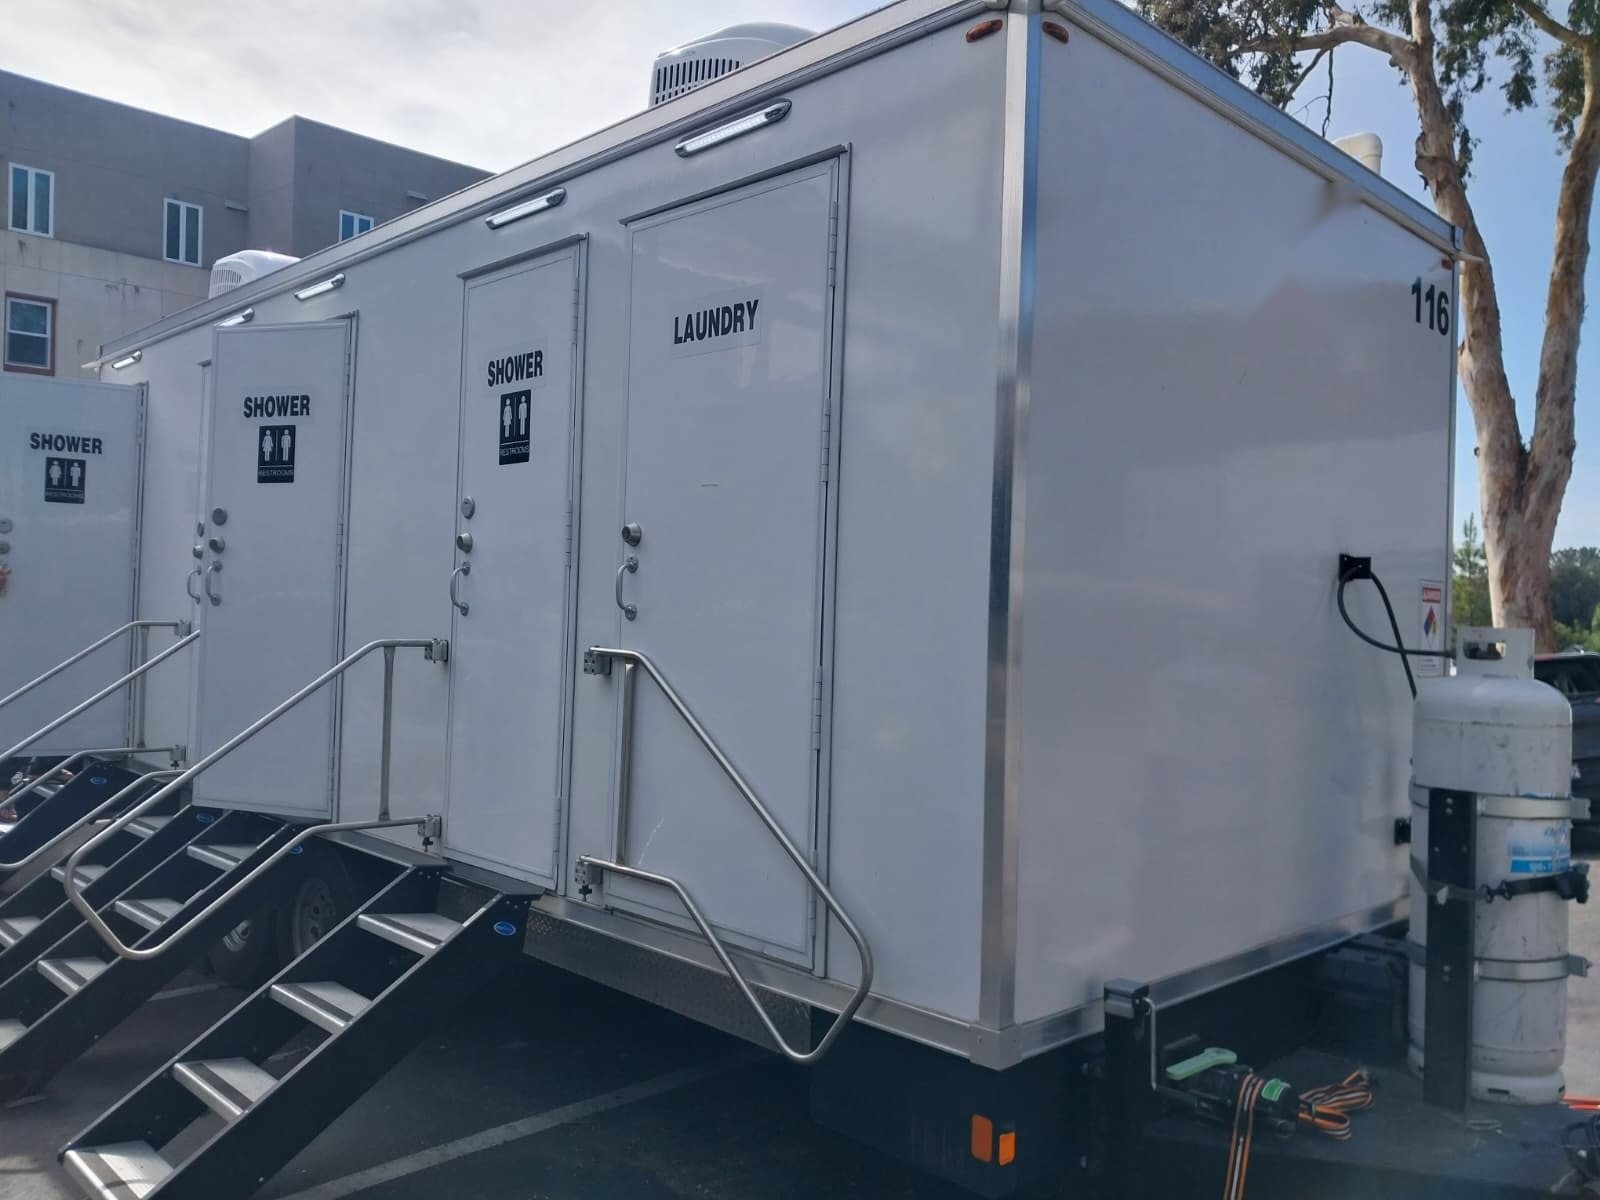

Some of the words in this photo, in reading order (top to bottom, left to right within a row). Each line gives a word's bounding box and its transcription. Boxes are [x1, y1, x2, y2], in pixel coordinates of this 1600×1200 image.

[674, 299, 759, 345] LAUNDRY
[1411, 276, 1449, 336] 116
[487, 349, 544, 388] SHOWER
[243, 394, 310, 419] SHOWER
[30, 432, 103, 455] SHOWER
